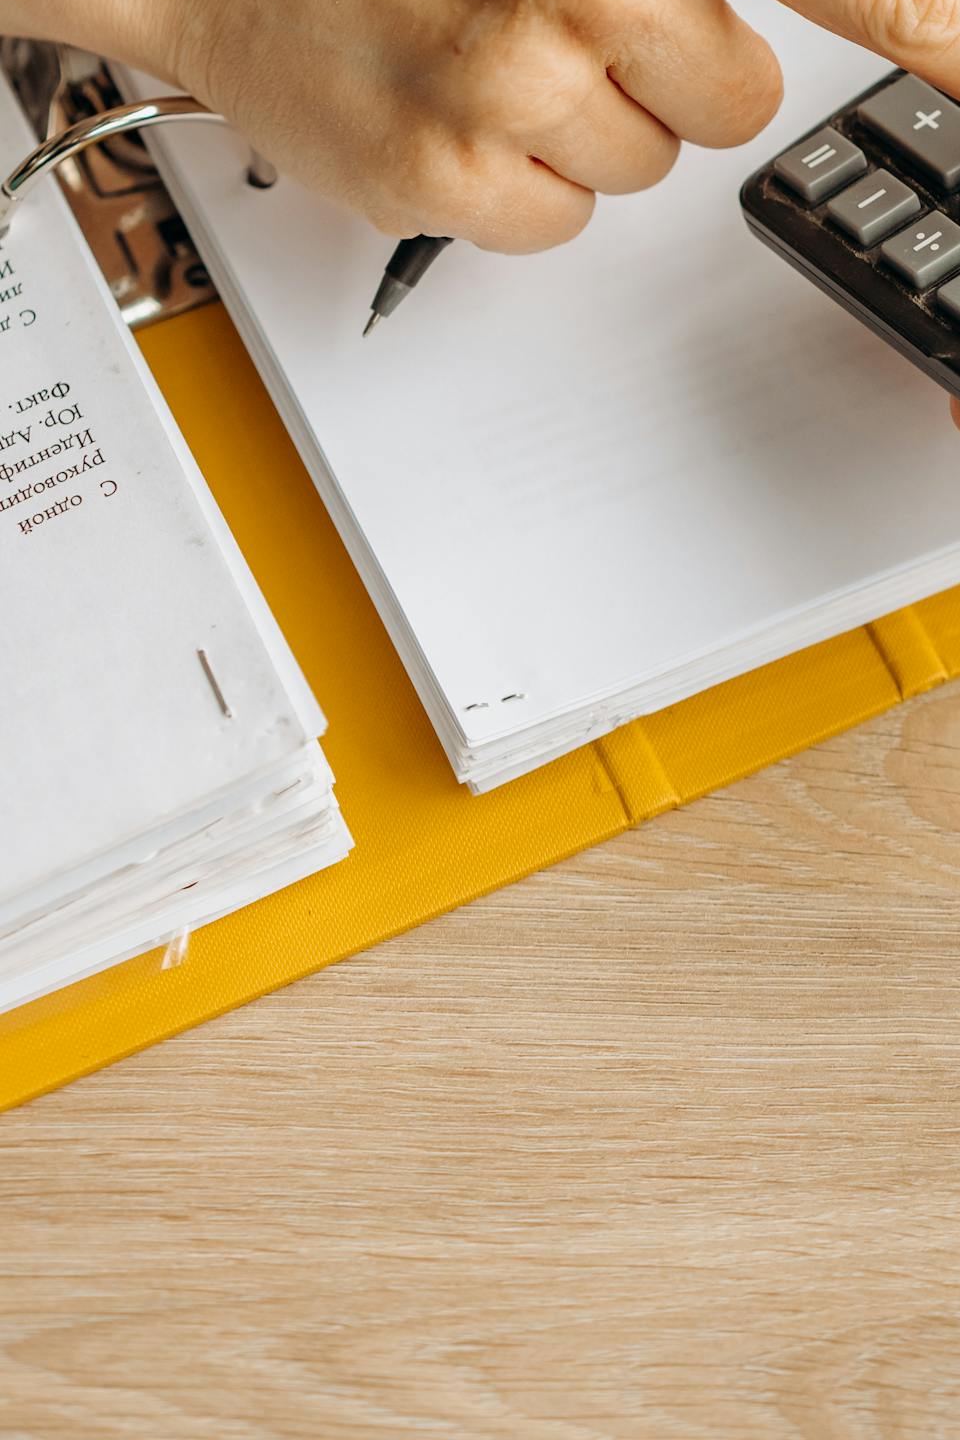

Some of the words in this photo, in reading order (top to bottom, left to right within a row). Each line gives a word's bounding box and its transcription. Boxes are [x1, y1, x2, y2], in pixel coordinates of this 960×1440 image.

[8, 381, 71, 414] Факт.
[39, 403, 84, 428] Юр.
[17, 494, 83, 535] одной
